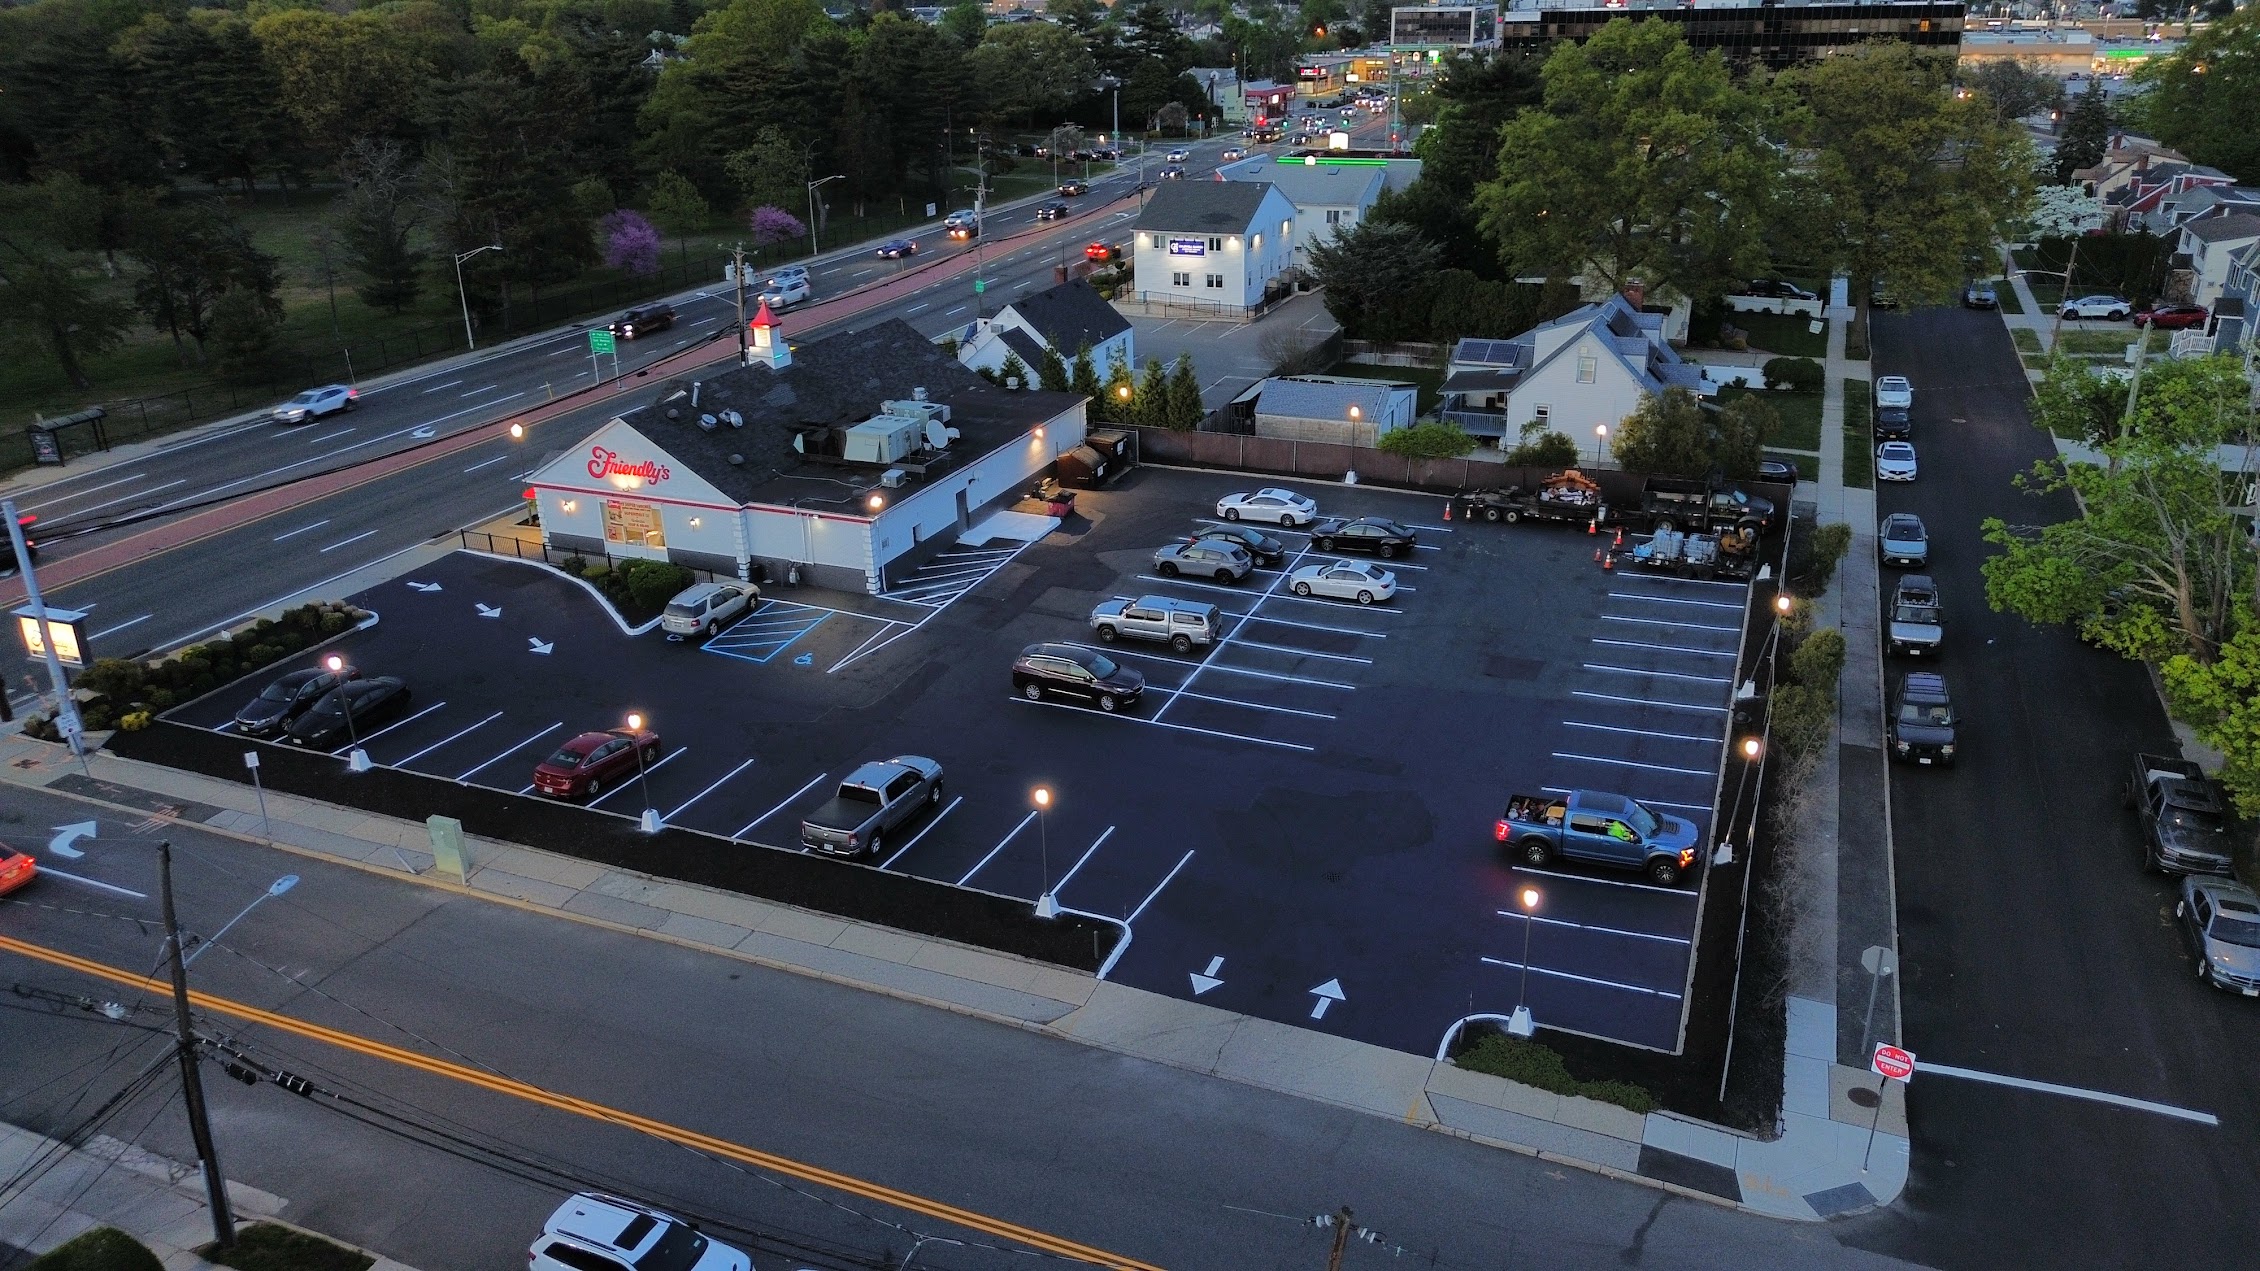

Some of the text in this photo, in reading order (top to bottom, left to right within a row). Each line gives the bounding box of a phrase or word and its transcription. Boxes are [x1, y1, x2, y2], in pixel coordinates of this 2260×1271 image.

[588, 446, 670, 485] Friendly's
[1881, 1049, 1909, 1062] DO NOT
[1881, 1063, 1903, 1074] ENTER
